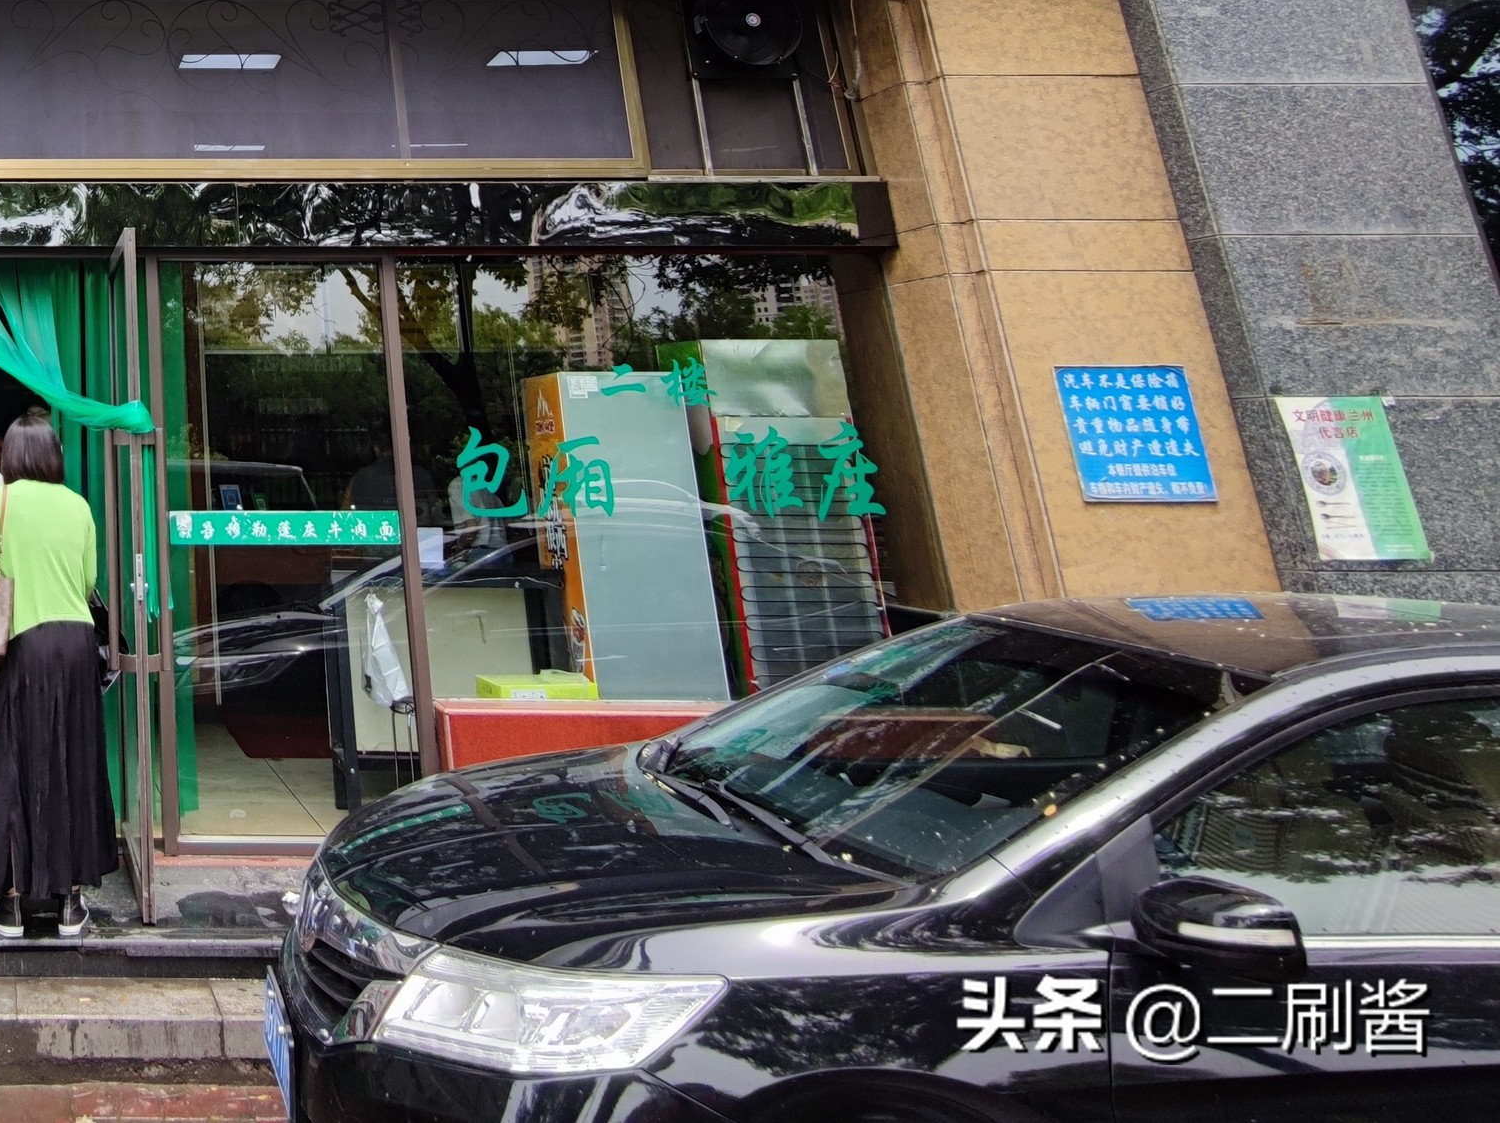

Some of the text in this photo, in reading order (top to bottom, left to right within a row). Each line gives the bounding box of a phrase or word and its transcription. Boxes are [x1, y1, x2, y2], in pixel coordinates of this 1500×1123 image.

[600, 356, 717, 408] 二楼
[1062, 372, 1180, 390] 汽车不是保险箱
[1292, 409, 1374, 422] 文明健康兰州
[1319, 427, 1359, 439] 代言店
[456, 427, 616, 518] 包厢
[725, 421, 886, 522] 雅座
